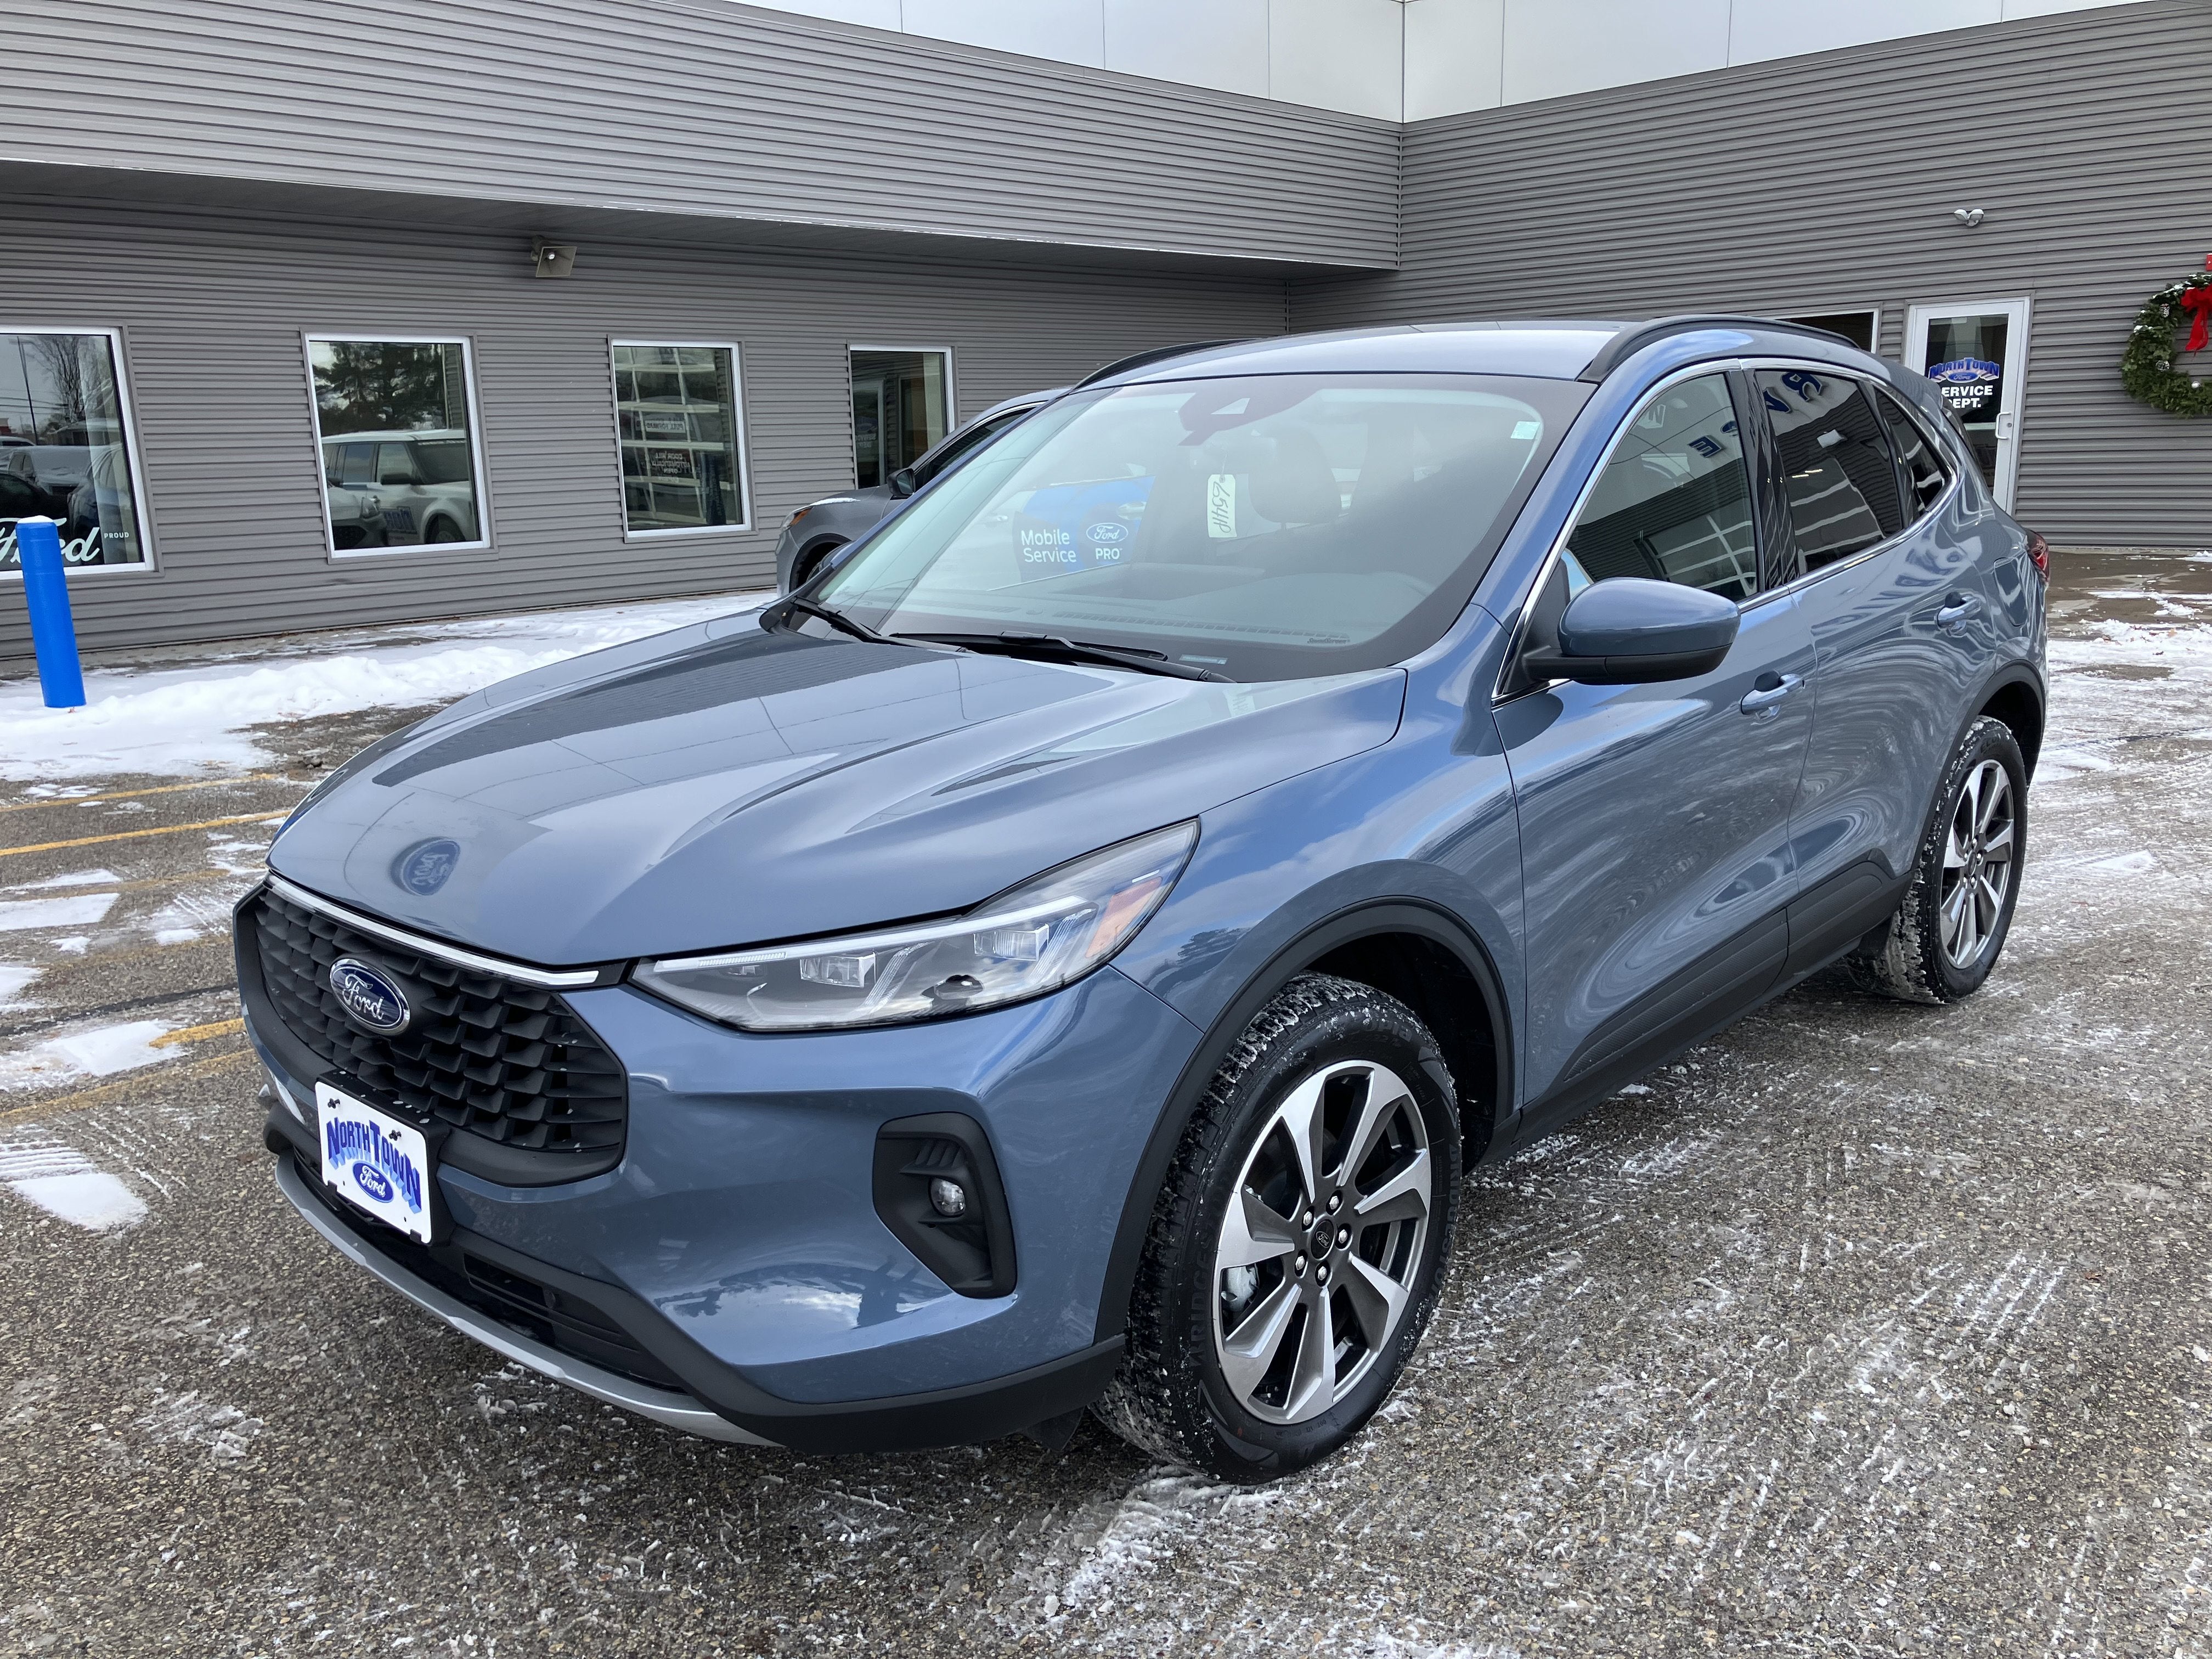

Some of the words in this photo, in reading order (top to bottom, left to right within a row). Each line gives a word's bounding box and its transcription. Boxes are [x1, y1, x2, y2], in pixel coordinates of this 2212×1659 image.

[1942, 385, 1993, 397] ERVICE
[1949, 398, 1981, 408] EPT.
[0, 517, 100, 563] Fd
[1021, 529, 1070, 546] Mobile
[1094, 525, 1120, 540] Ford
[1023, 548, 1077, 563] Service
[342, 973, 385, 1020] Ford
[359, 1165, 386, 1198] Ford
